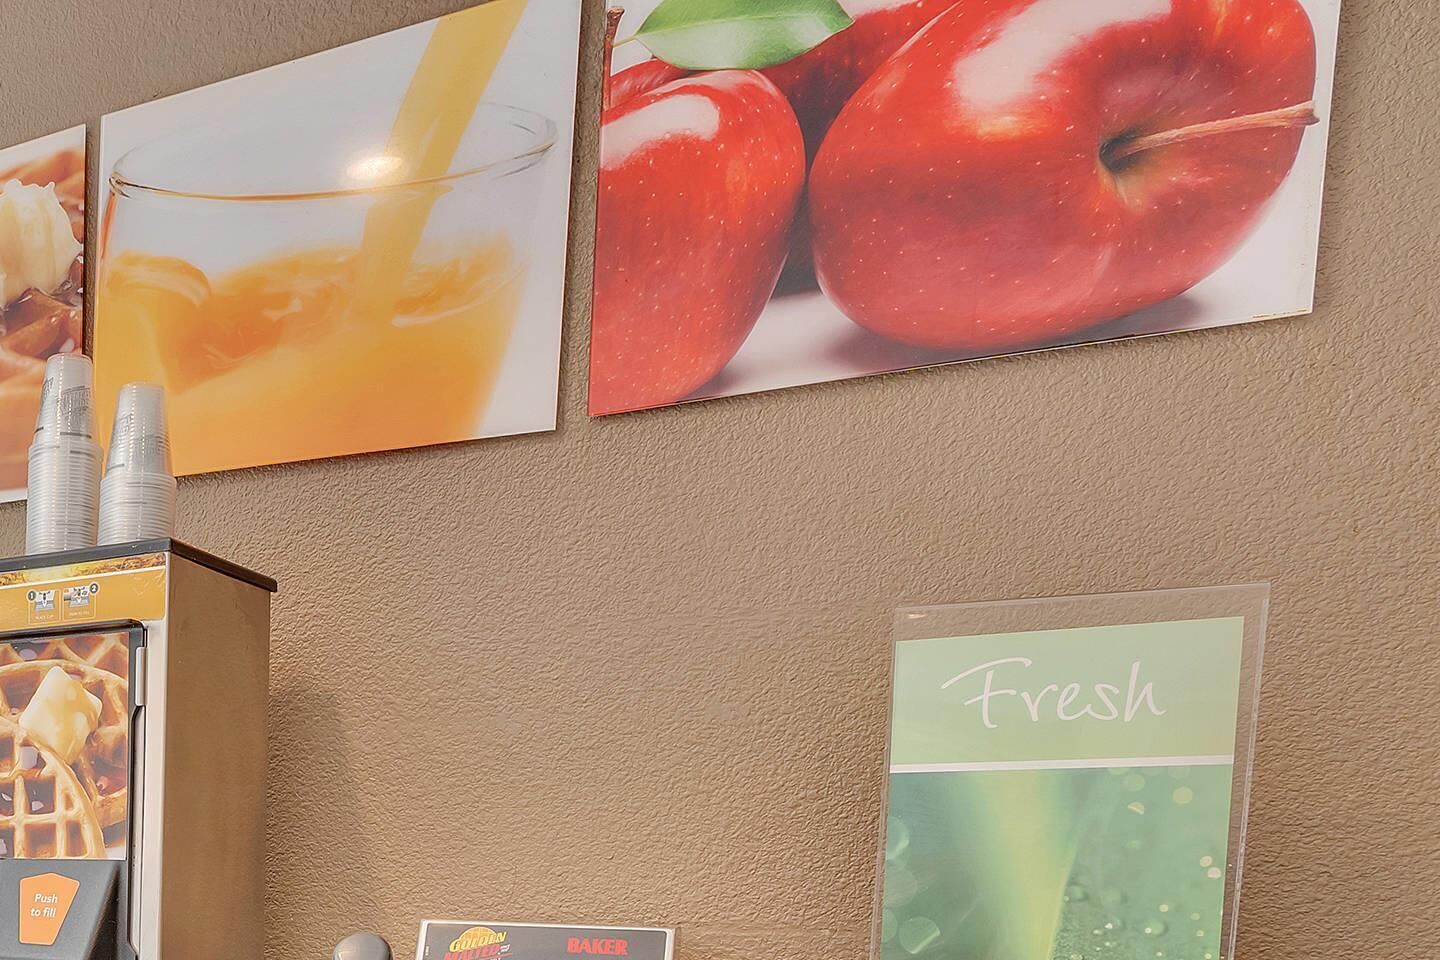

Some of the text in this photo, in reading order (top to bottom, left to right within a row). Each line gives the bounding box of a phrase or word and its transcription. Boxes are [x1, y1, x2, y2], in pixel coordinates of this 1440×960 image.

[940, 656, 1167, 729] Fresh
[34, 893, 58, 904] Push
[31, 907, 57, 918] to fill
[449, 931, 507, 953] GOLDEN
[567, 937, 629, 956] BAKER
